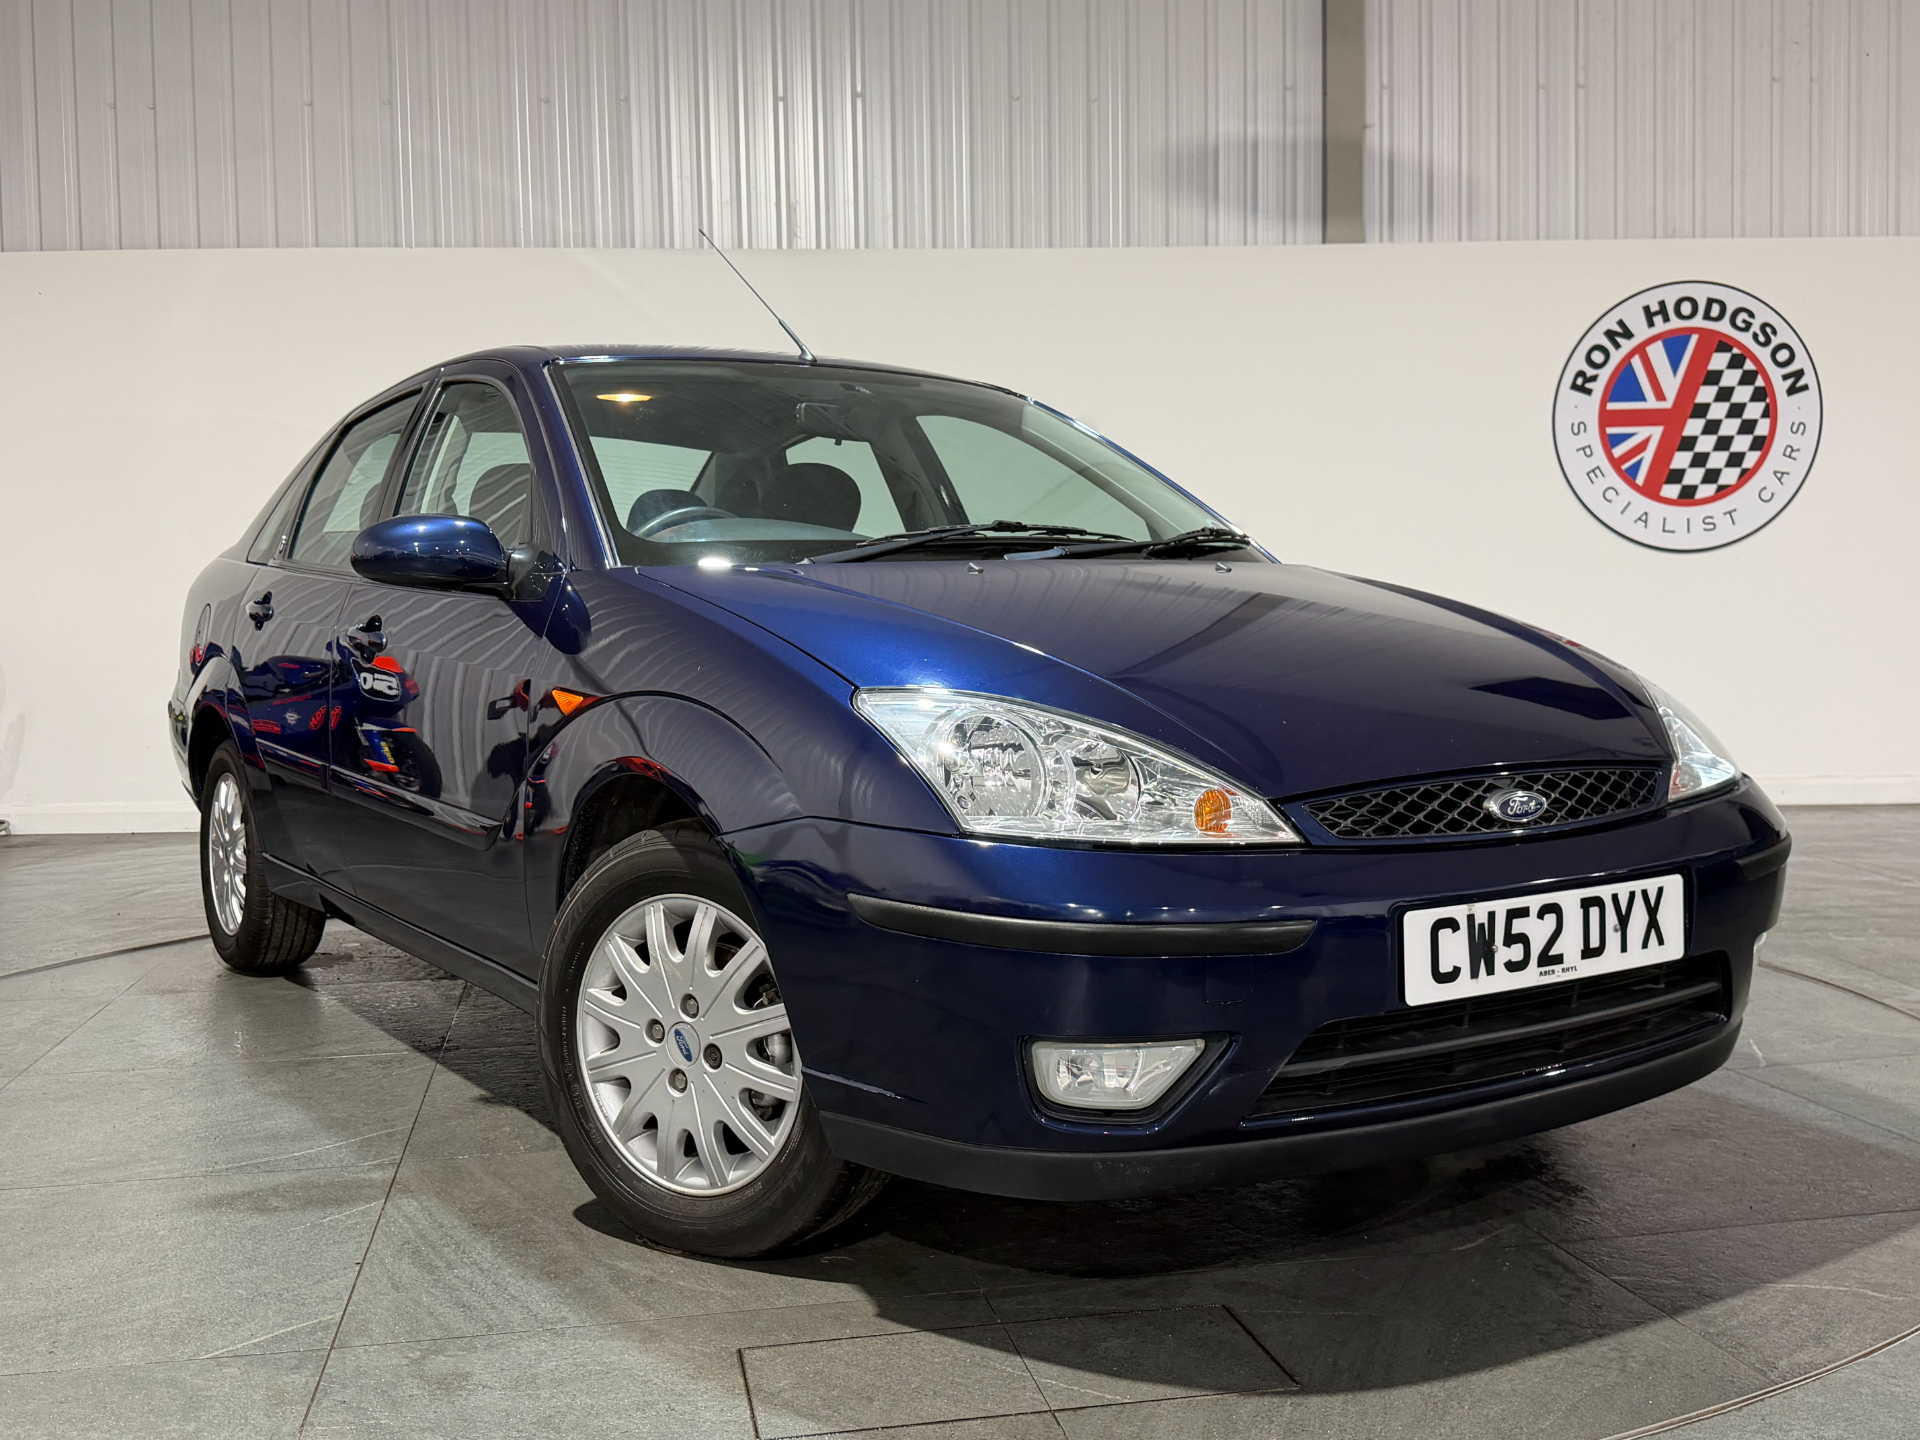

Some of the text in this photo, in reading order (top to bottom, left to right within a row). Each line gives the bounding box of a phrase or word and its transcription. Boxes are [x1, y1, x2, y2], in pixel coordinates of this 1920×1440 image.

[1569, 296, 1810, 398] RON HODGSON
[1570, 420, 1807, 534] SPECIALIST CARS
[1507, 796, 1541, 815] Ford
[1430, 886, 1665, 985] CW52 DYX
[1538, 968, 1556, 978] ABER
[1561, 965, 1578, 974] RHYL
[676, 1035, 690, 1056] Ford
